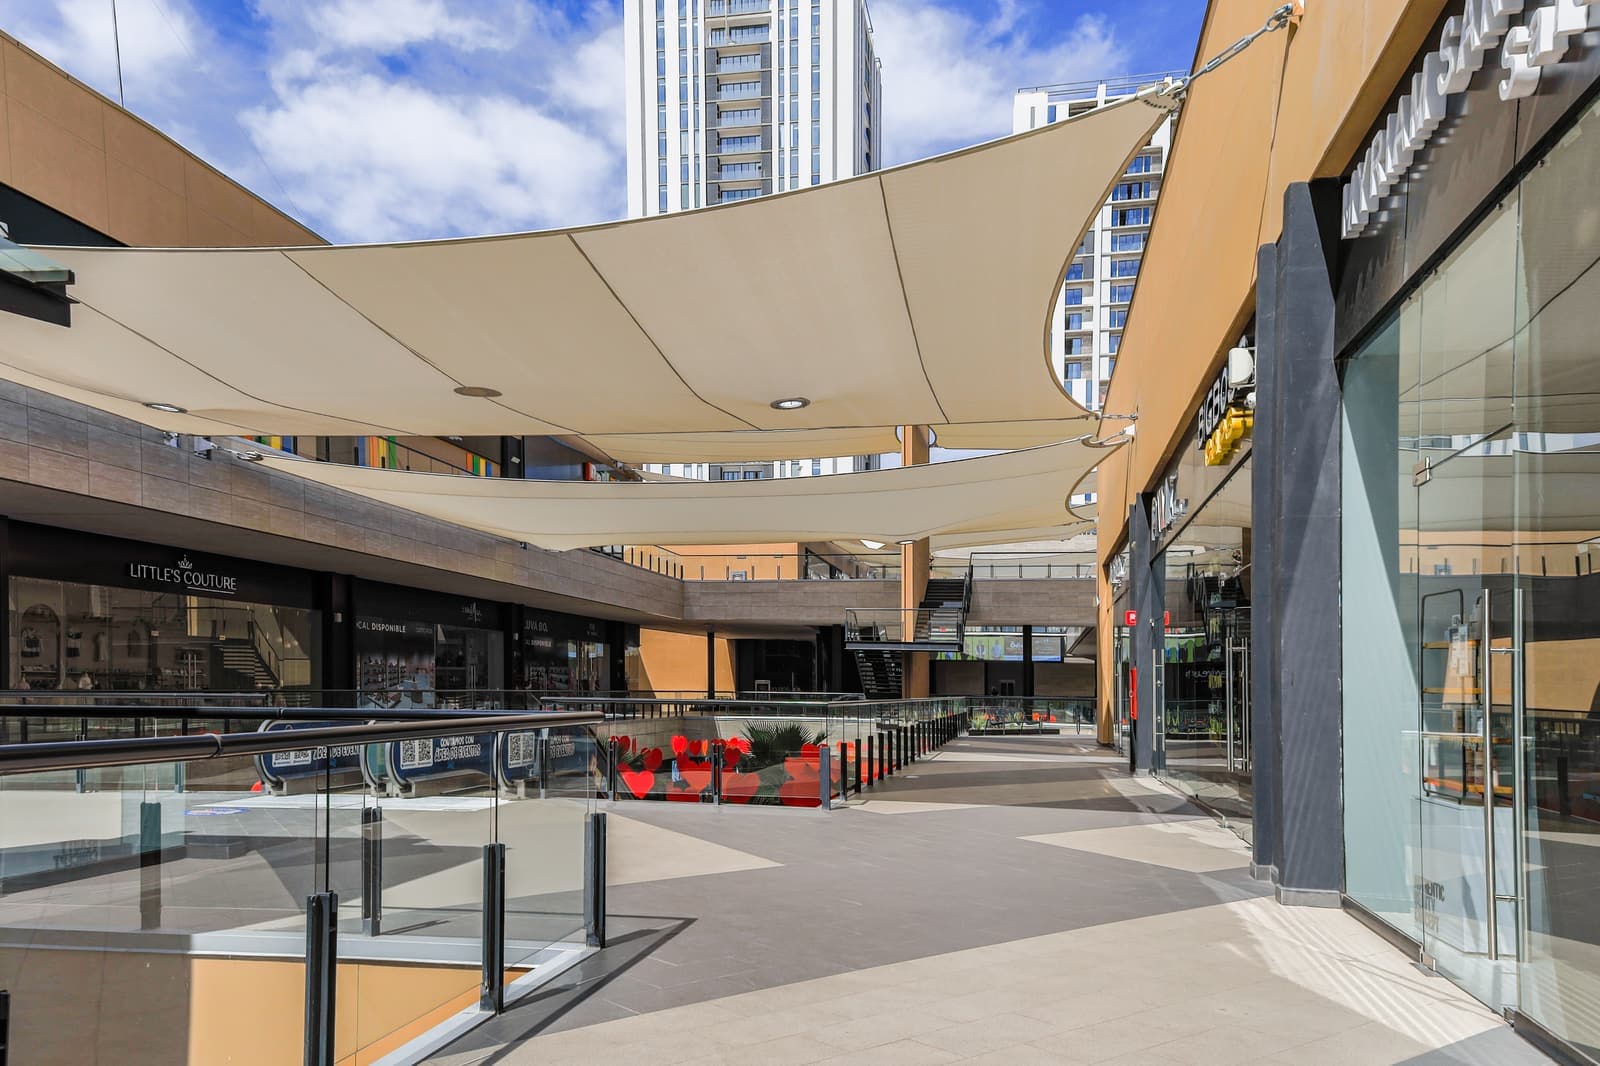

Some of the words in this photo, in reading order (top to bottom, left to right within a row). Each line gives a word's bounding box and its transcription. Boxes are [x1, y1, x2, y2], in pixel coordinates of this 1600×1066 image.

[130, 562, 181, 583] LITTLE'S
[183, 571, 237, 591] COUTURE
[371, 622, 406, 633] DISPONIBLE
